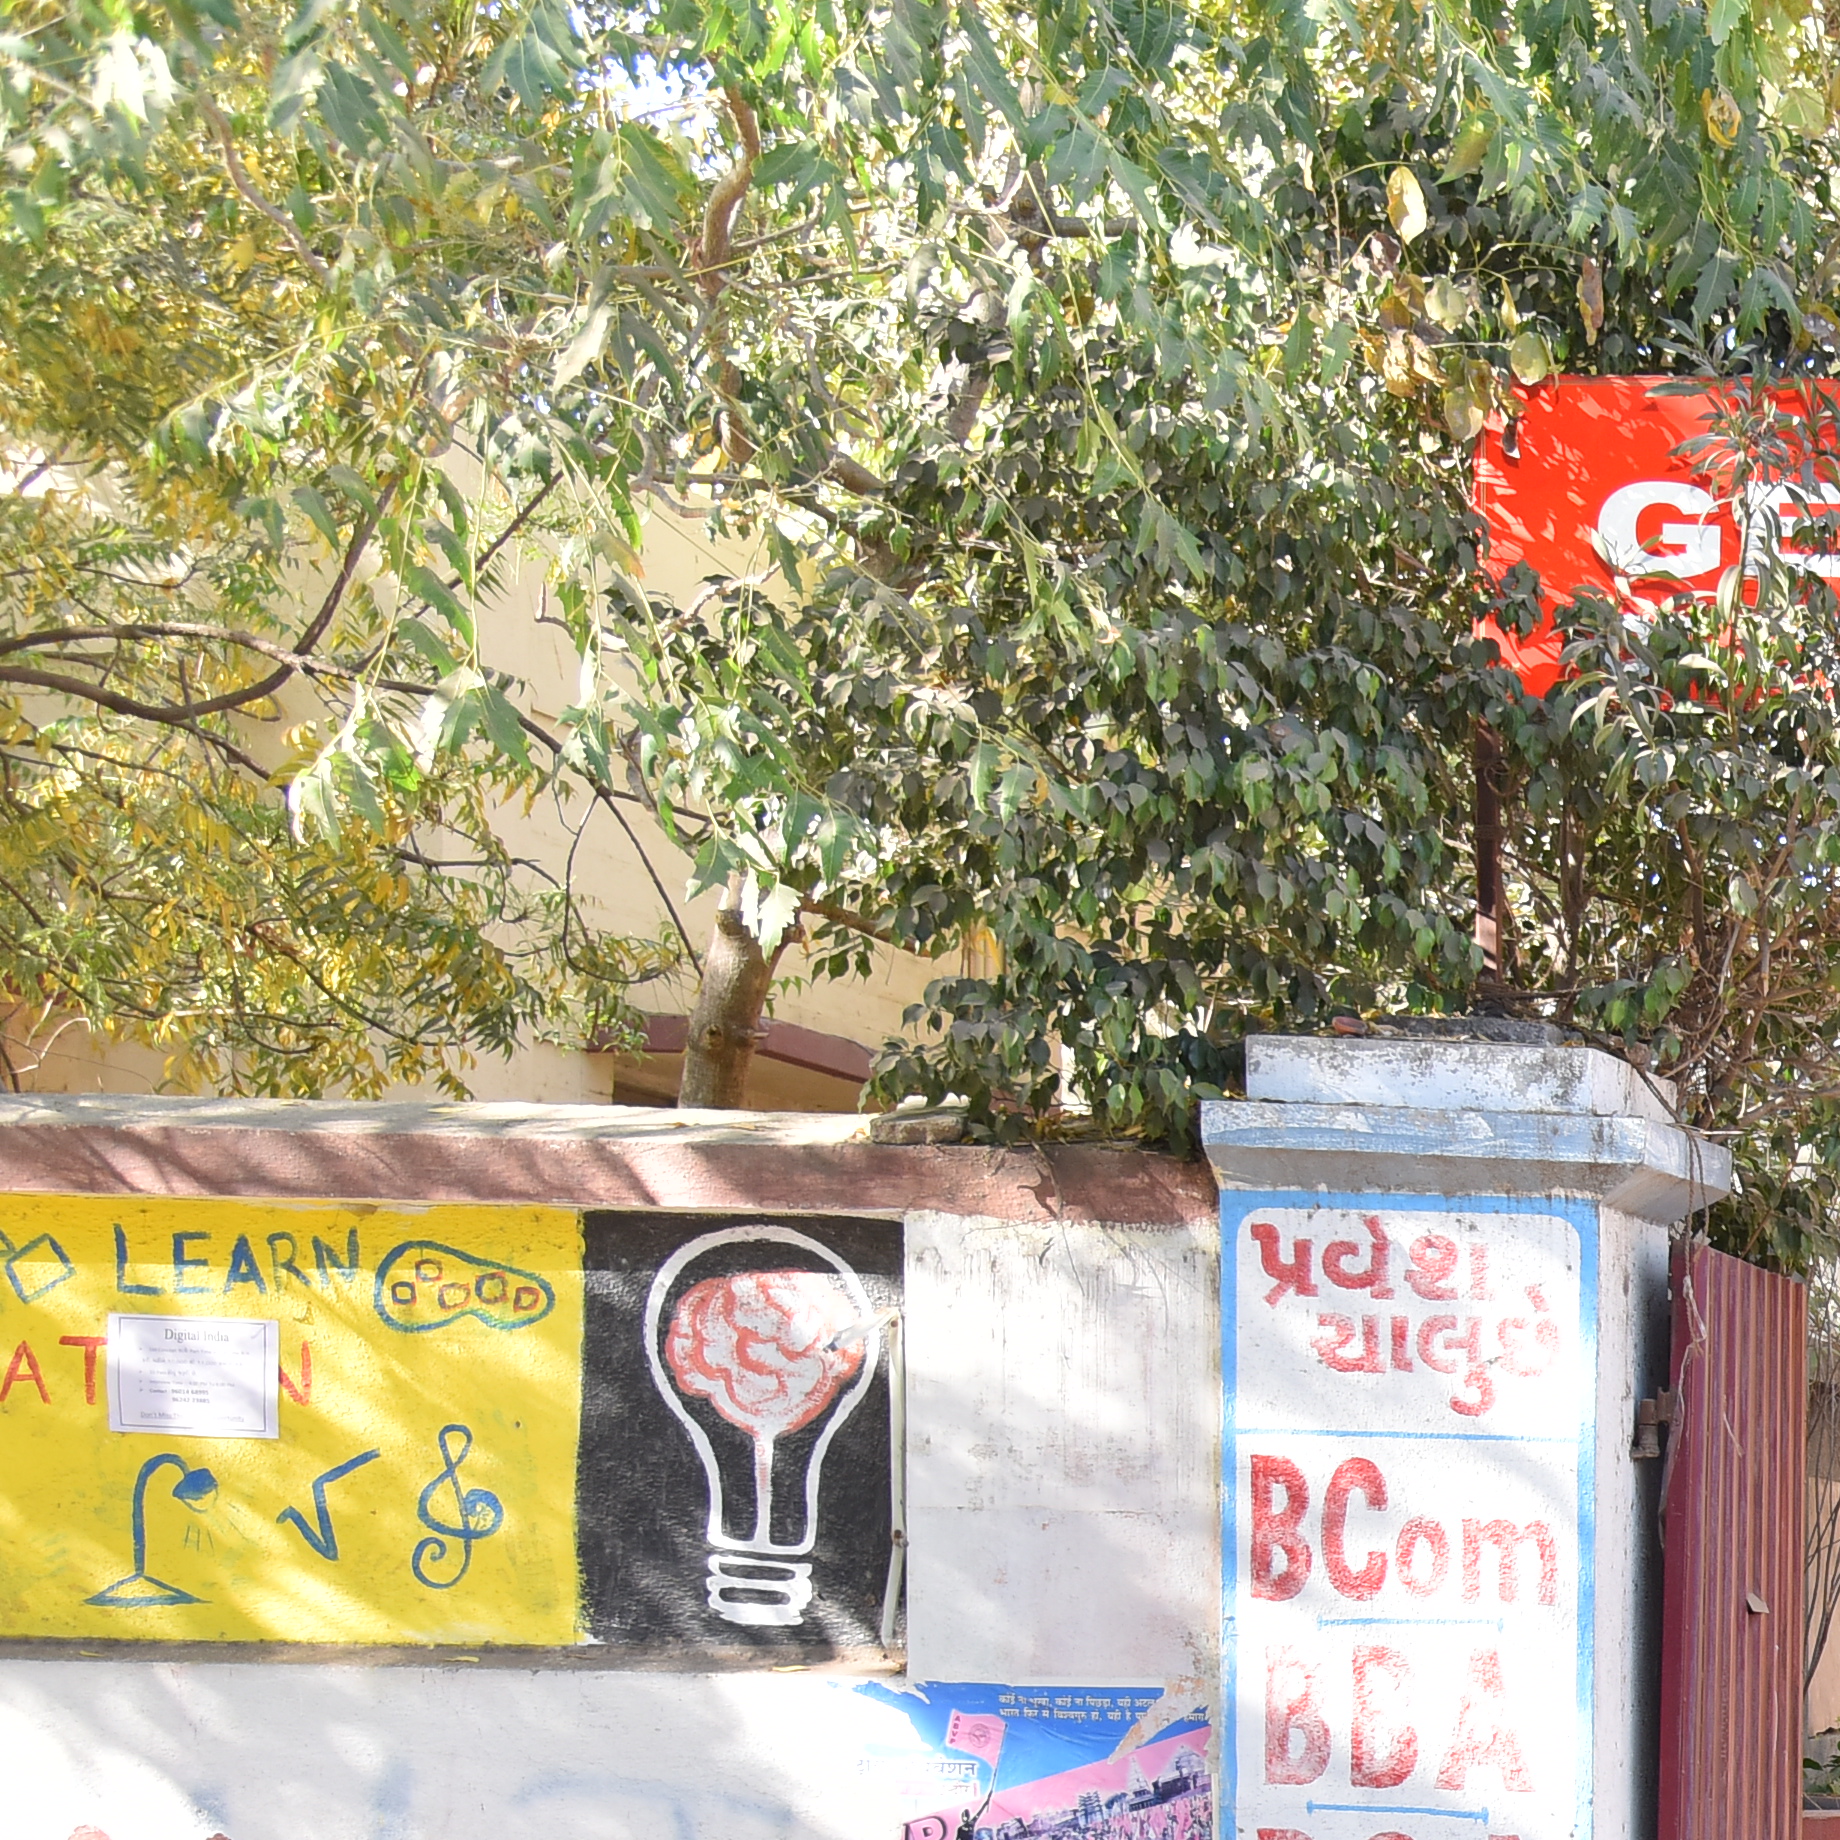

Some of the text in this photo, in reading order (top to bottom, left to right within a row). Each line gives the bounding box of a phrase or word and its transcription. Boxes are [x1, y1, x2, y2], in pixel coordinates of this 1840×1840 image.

[112, 1222, 361, 1296] LEARN
[0, 1335, 313, 1407] ATN
[164, 1328, 230, 1343] Digital India
[1250, 1454, 1561, 1605] BCom
